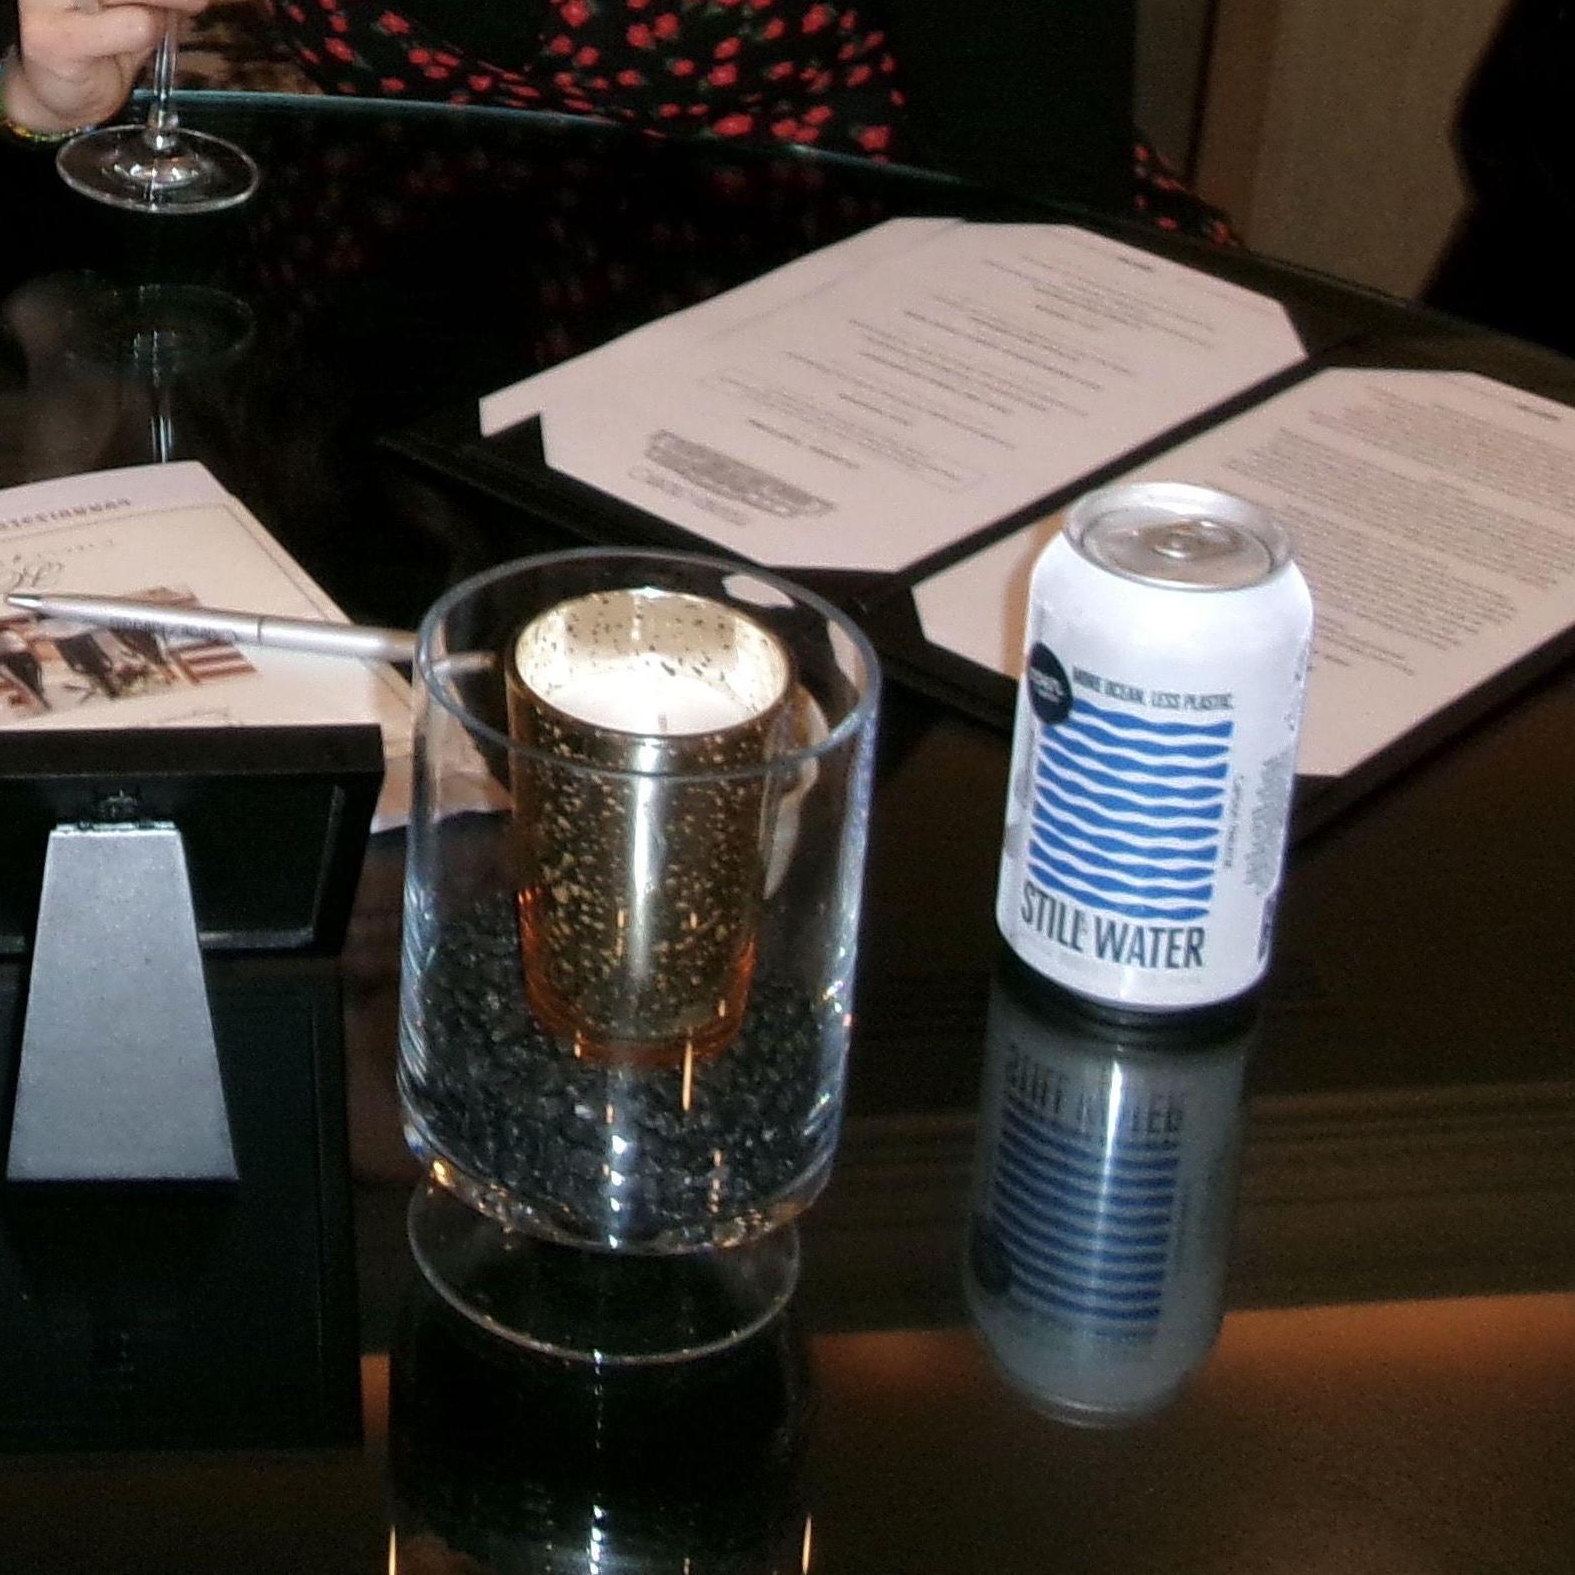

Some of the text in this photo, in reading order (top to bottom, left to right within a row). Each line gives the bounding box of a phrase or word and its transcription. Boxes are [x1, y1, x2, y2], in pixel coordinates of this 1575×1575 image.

[1151, 690, 1181, 710] LESS
[1020, 879, 1206, 970] STILL WATER
